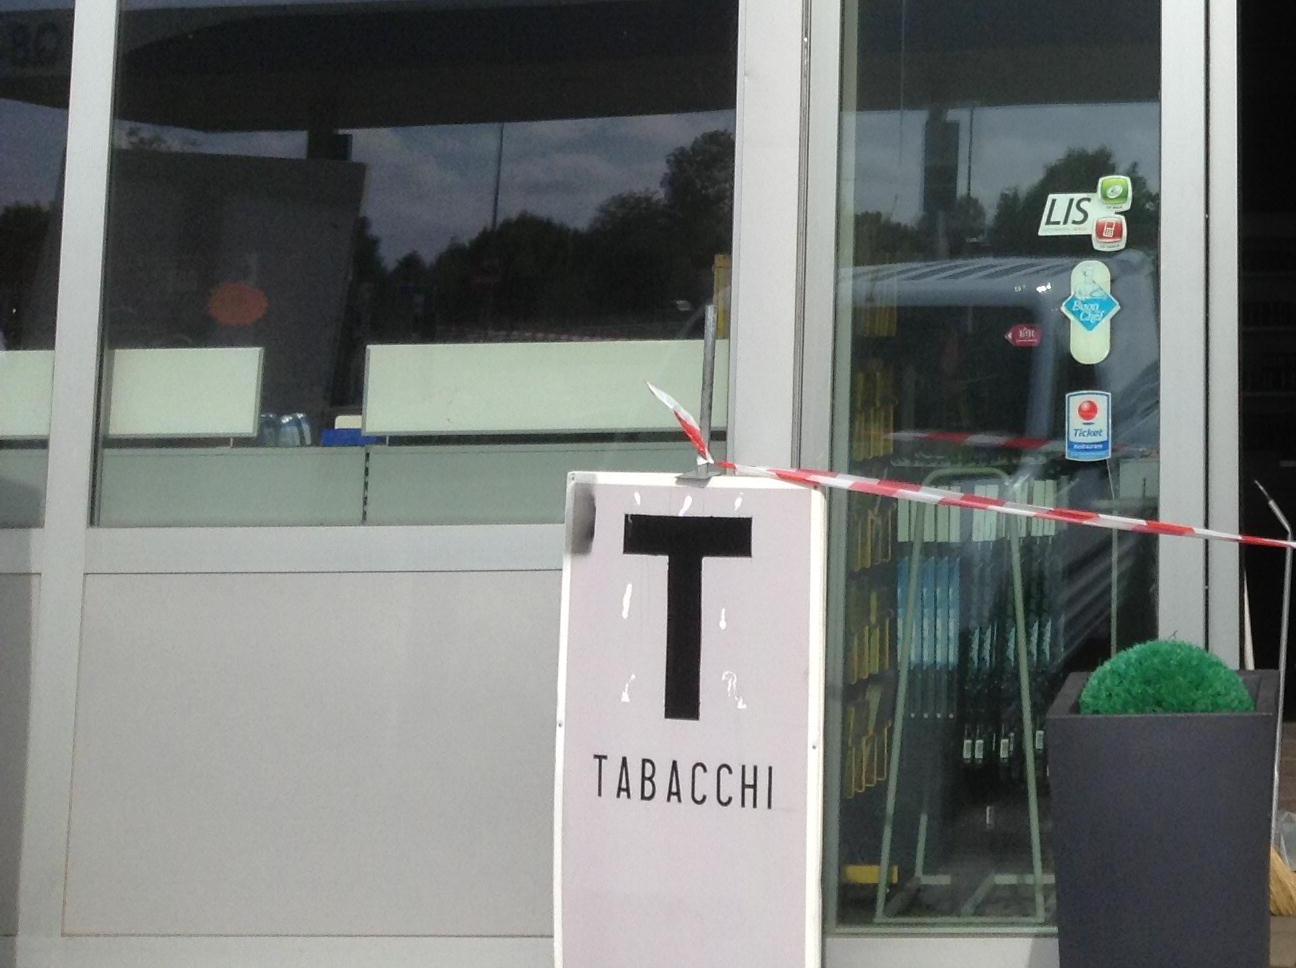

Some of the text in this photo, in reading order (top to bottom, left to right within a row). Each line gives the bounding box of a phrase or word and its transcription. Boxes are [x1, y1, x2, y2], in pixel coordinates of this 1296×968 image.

[1044, 197, 1092, 226] LIS
[1073, 428, 1103, 437] Ticket
[623, 513, 753, 721] T
[593, 754, 773, 810] TABACCHI
